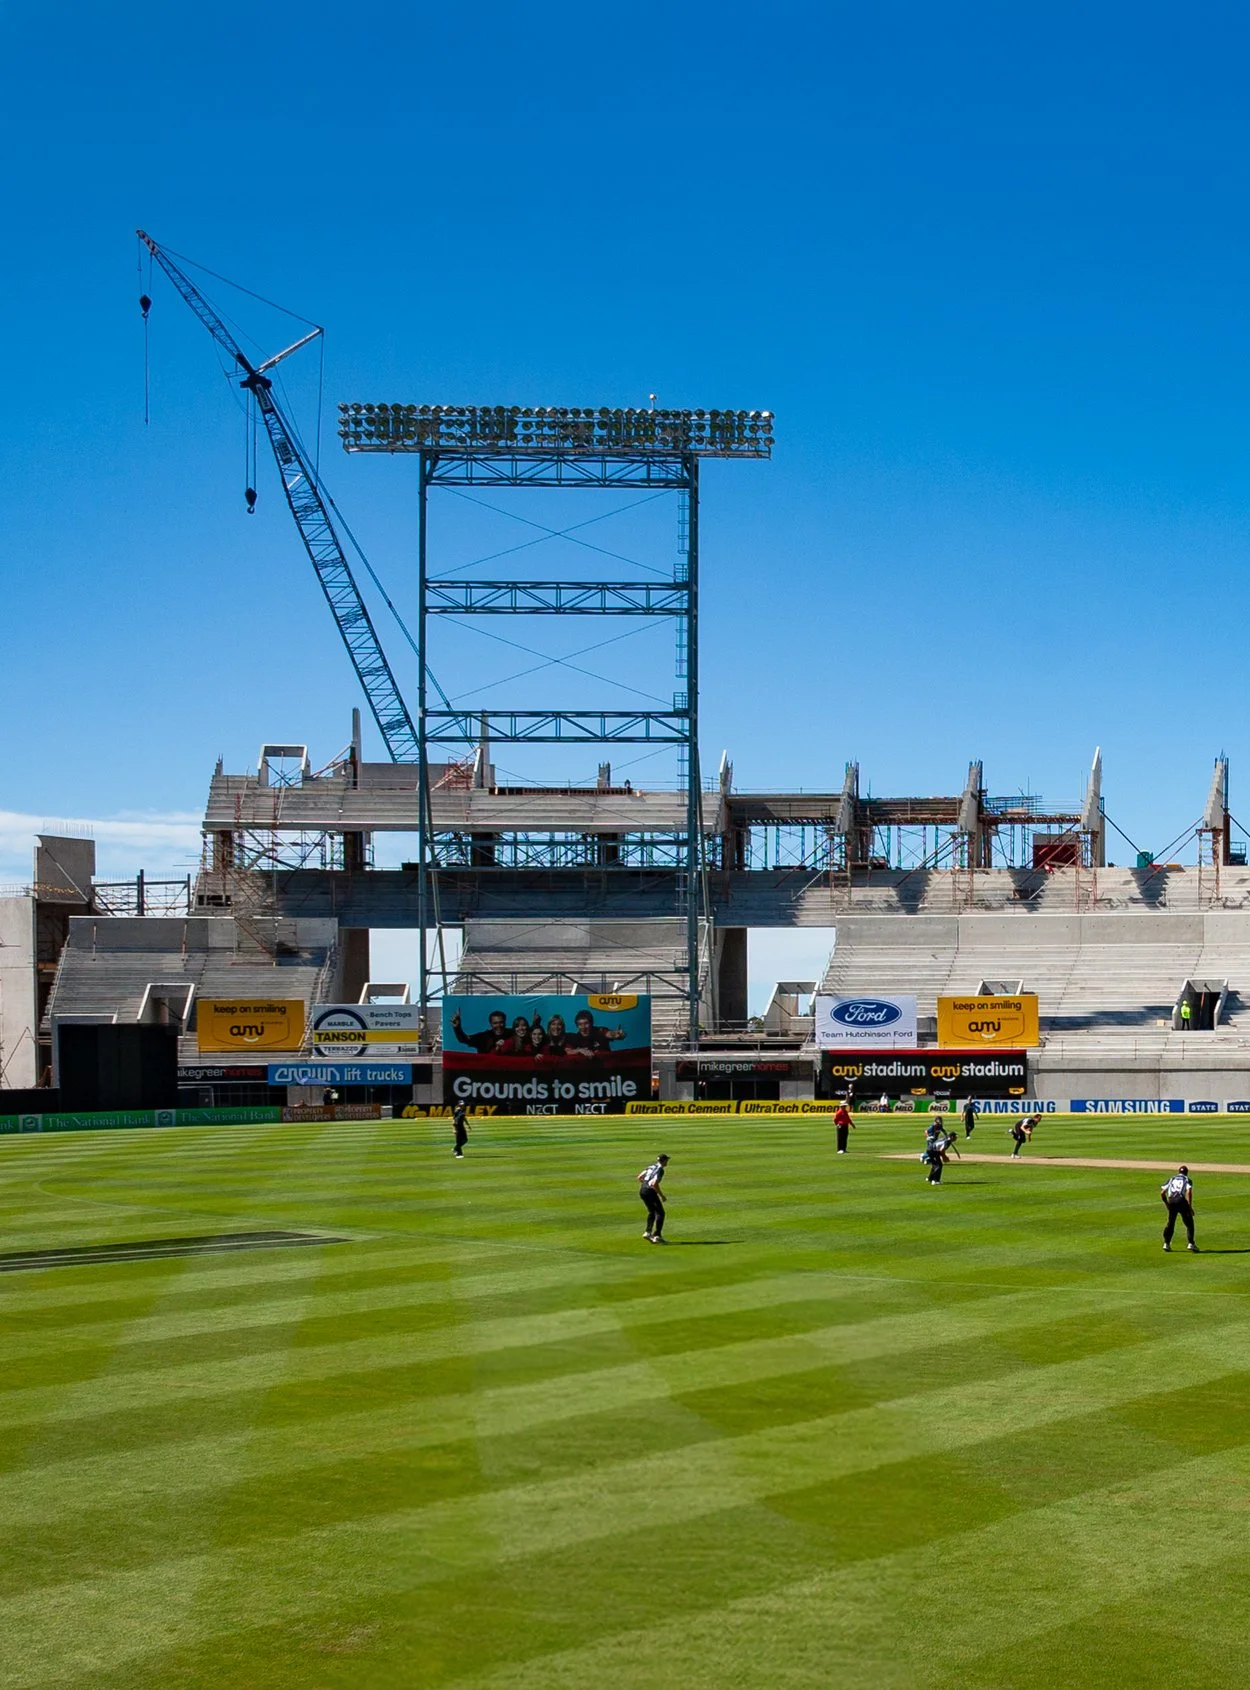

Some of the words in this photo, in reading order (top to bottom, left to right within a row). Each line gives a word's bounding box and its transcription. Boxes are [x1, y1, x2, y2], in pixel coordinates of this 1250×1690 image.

[214, 1004, 236, 1015] keep
[239, 1006, 252, 1014] on
[253, 1004, 286, 1015] smiling
[953, 1002, 975, 1012] keep
[990, 1001, 1022, 1012] smiling
[845, 1003, 887, 1022] Ford
[315, 1032, 366, 1042] TANSON
[344, 1068, 361, 1080] lift
[366, 1068, 404, 1081] trucks
[453, 1076, 548, 1099] Grounds
[552, 1079, 576, 1099] to
[578, 1076, 637, 1099] smile
[428, 1104, 498, 1118] MALEY
[526, 1104, 559, 1115] NZCT
[574, 1103, 608, 1115] NZCT
[630, 1104, 685, 1114] UltraTech
[688, 1104, 732, 1114] Cement
[744, 1104, 799, 1114] UltraTech
[802, 1104, 842, 1114] Cemen
[895, 1104, 914, 1112] MILO
[930, 1104, 948, 1112] MILO
[972, 1100, 1056, 1113] SAMSUNG
[1086, 1100, 1170, 1113] SAMSUNG
[1190, 1104, 1216, 1112] STATE
[46, 1117, 70, 1128] The
[72, 1116, 120, 1127] National
[123, 1115, 150, 1126] Bank
[181, 1112, 198, 1122] The
[202, 1110, 248, 1122] National
[250, 1110, 276, 1121] Bank
